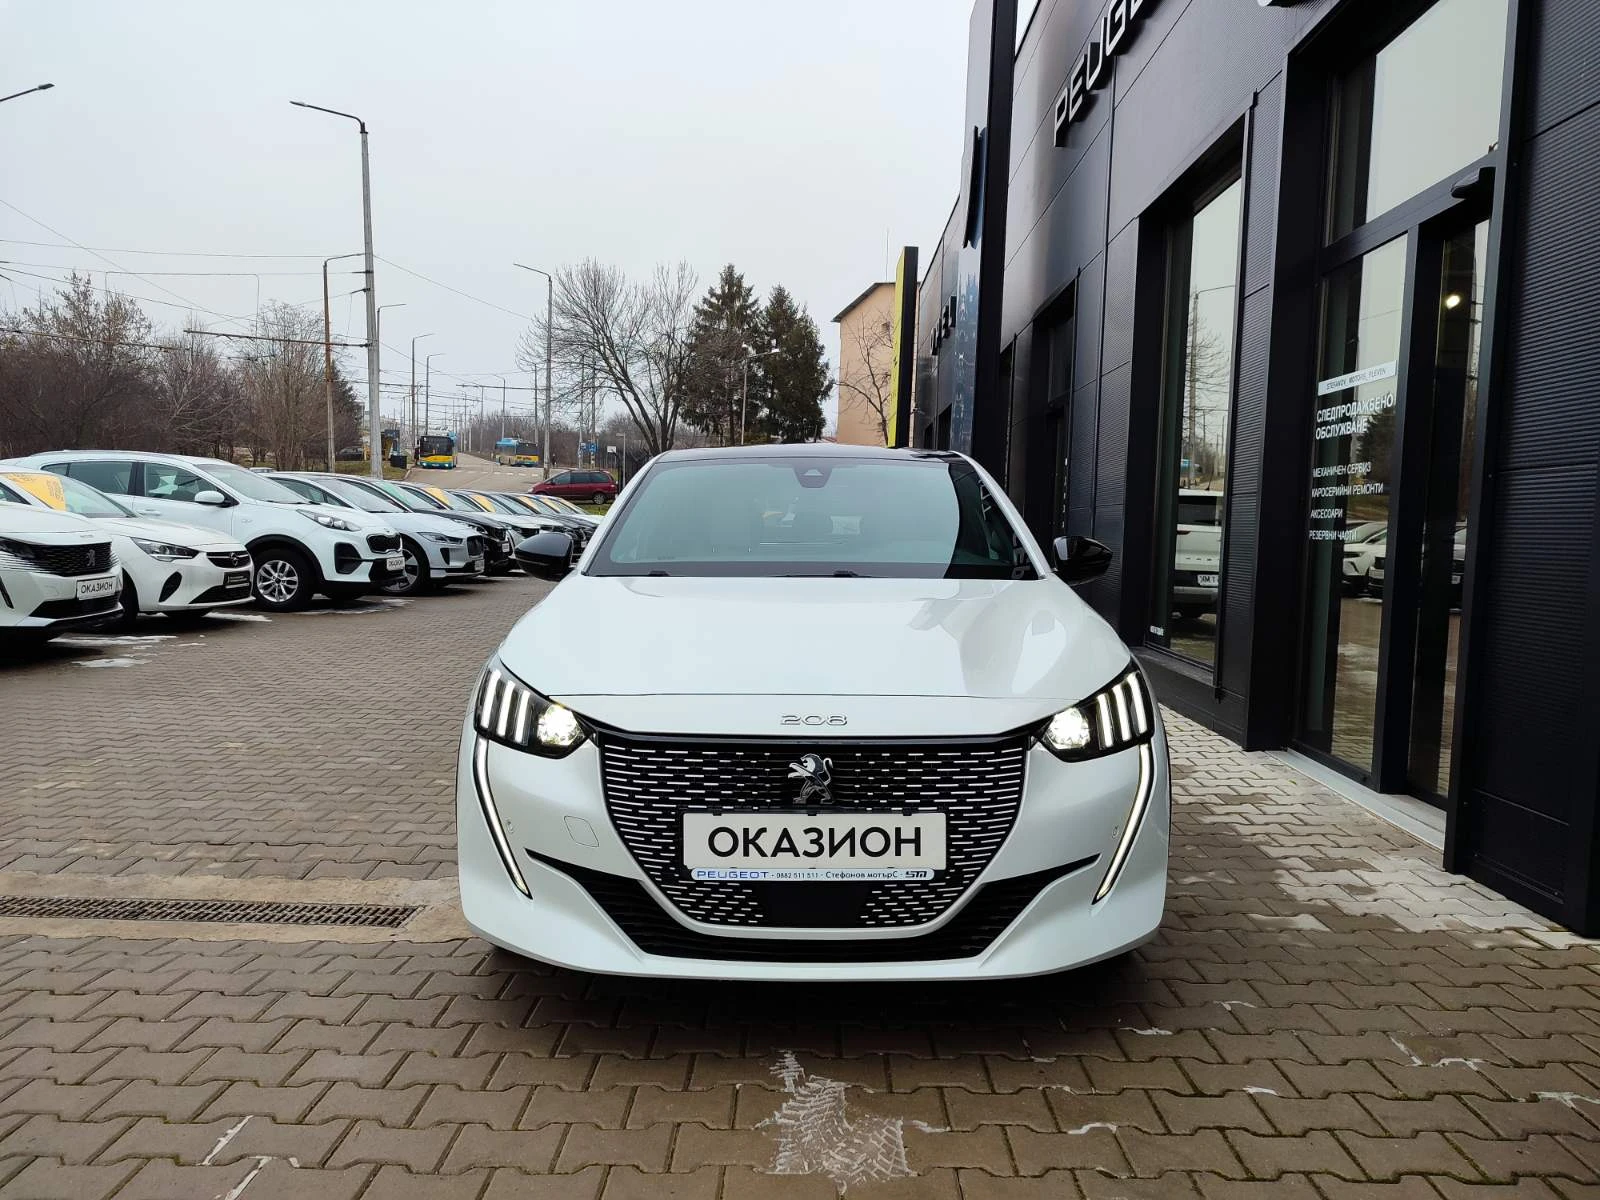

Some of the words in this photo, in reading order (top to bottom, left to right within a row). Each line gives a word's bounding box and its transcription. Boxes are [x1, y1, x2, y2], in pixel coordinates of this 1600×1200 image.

[1315, 416, 1369, 440] ОБСЛУЖВАНЕ
[1352, 482, 1384, 495] РЕМОНТИ
[80, 581, 113, 595] ОКАЗИОН
[780, 714, 848, 726] 208
[708, 826, 921, 858] ОКАЗИОН
[696, 870, 769, 879] PEUGEOT
